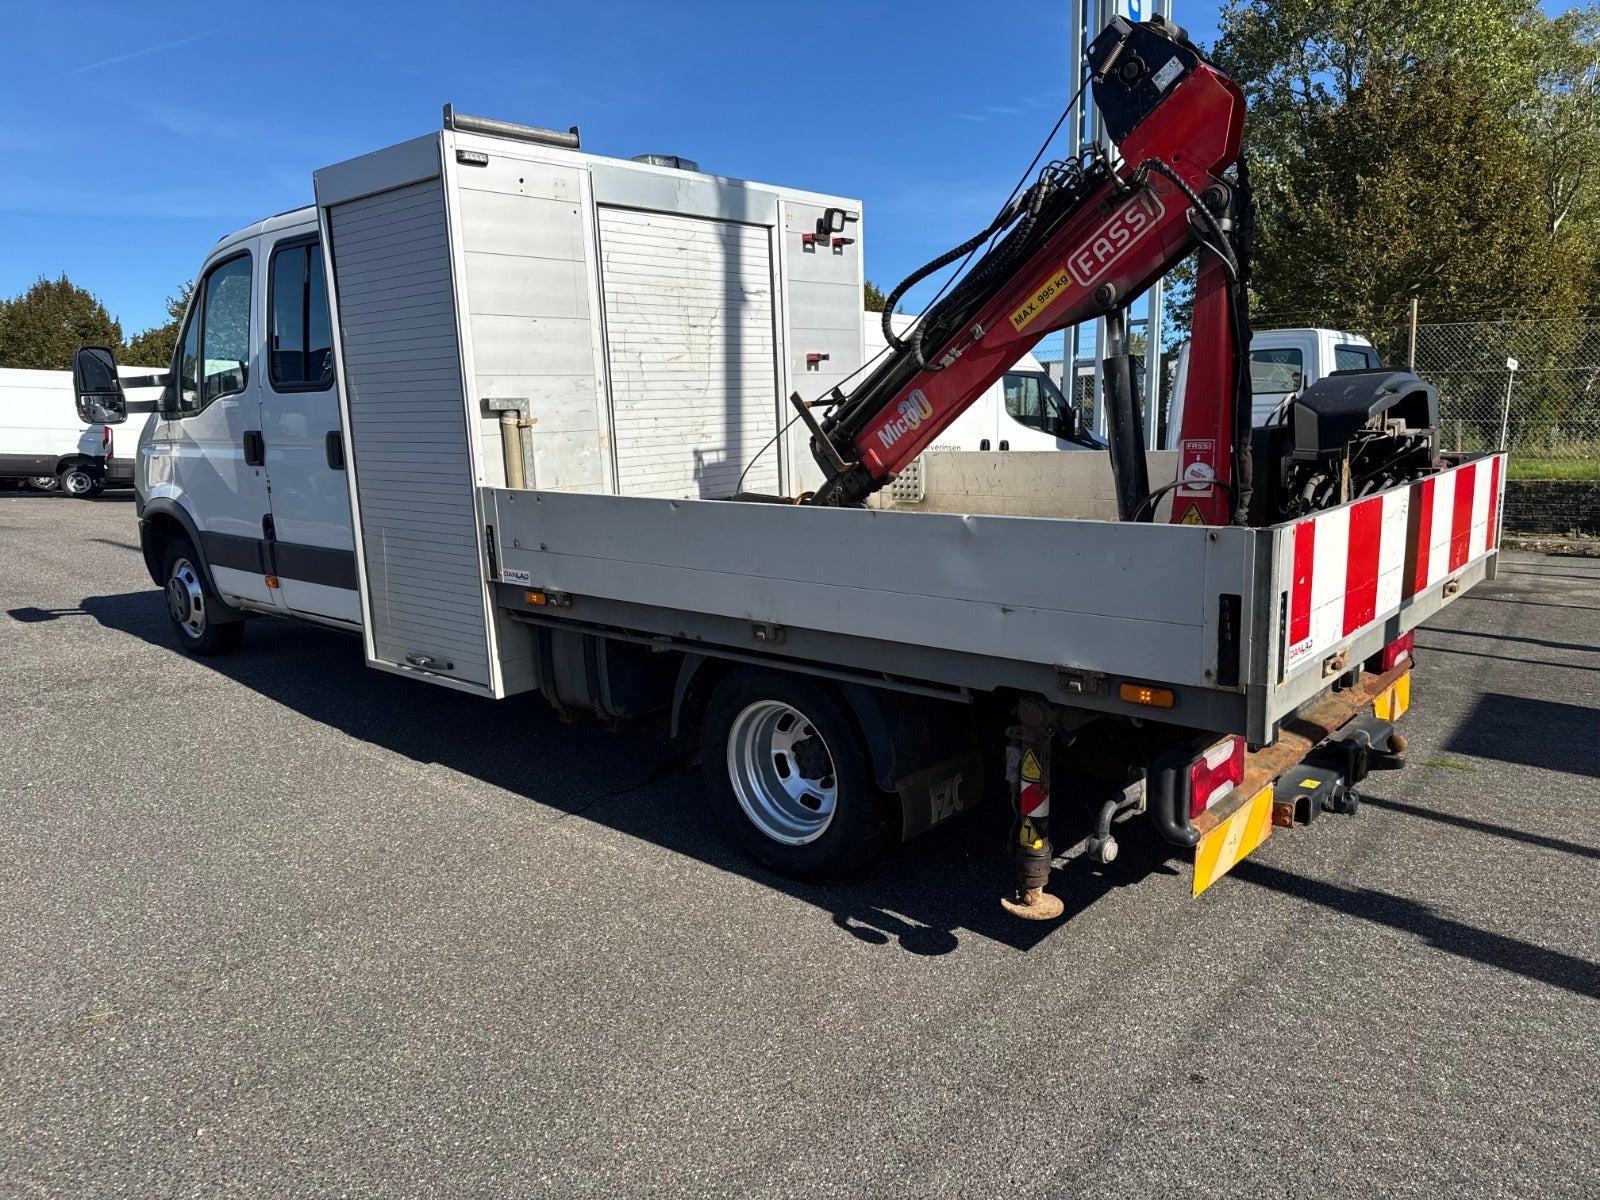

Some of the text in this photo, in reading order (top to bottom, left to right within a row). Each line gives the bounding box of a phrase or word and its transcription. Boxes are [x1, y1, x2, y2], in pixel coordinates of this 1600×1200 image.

[1077, 192, 1154, 276] FASSI
[1014, 275, 1069, 326] MAX. 995 kg
